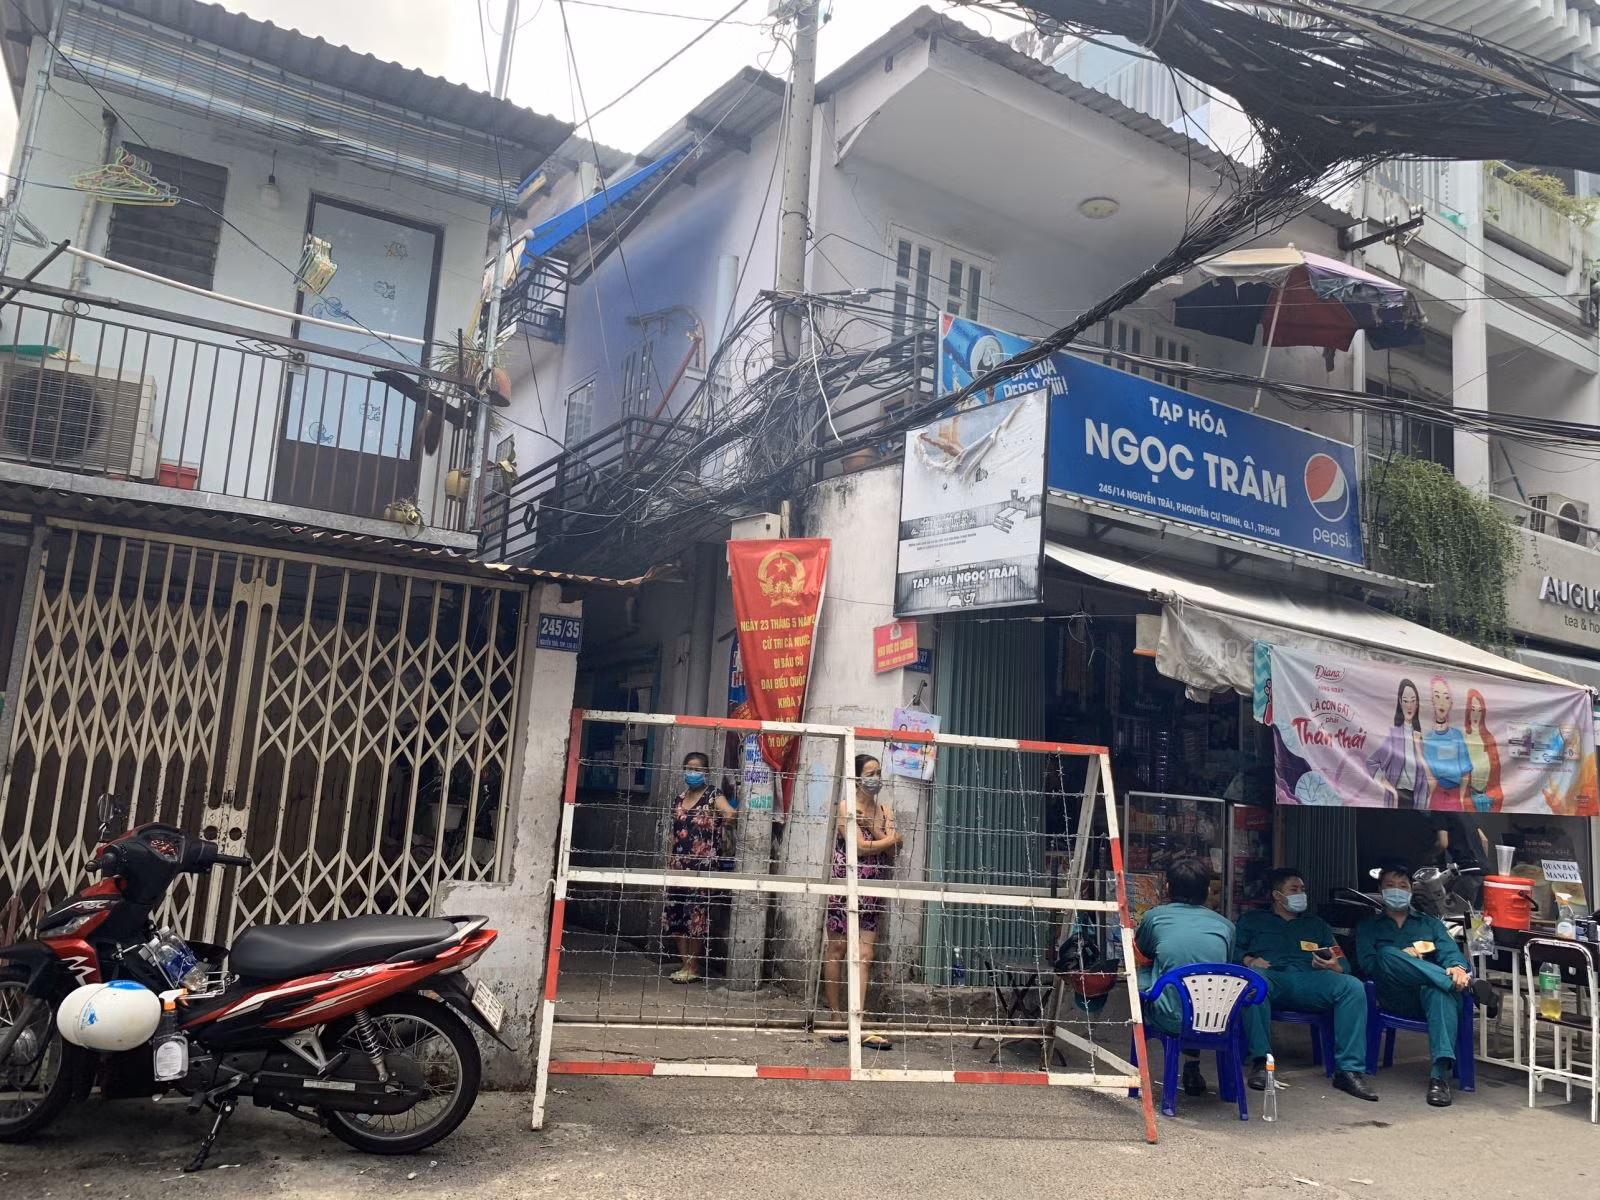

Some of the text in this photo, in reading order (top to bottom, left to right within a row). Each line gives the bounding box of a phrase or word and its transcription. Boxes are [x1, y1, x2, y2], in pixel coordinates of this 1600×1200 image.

[1149, 396, 1228, 438] TẠP HÓA
[1085, 417, 1287, 508] NGỌC TRÂM
[1099, 483, 1125, 498] 245/14
[1126, 491, 1156, 505] NGUYỄN
[1210, 511, 1221, 522] CƯ
[1257, 525, 1280, 537] TP.HCM
[1313, 527, 1349, 549] pepsi
[912, 578, 930, 592] TẠP
[956, 569, 986, 585] NGỌC
[988, 564, 1019, 579] TRÂM
[541, 617, 580, 639] 245/35
[760, 619, 769, 631] 23
[791, 617, 797, 628] 5
[1564, 614, 1579, 628] tea
[1580, 618, 1587, 631] &
[1315, 665, 1343, 681] Diana
[1310, 698, 1320, 712] LÀ
[1321, 700, 1336, 710] CON
